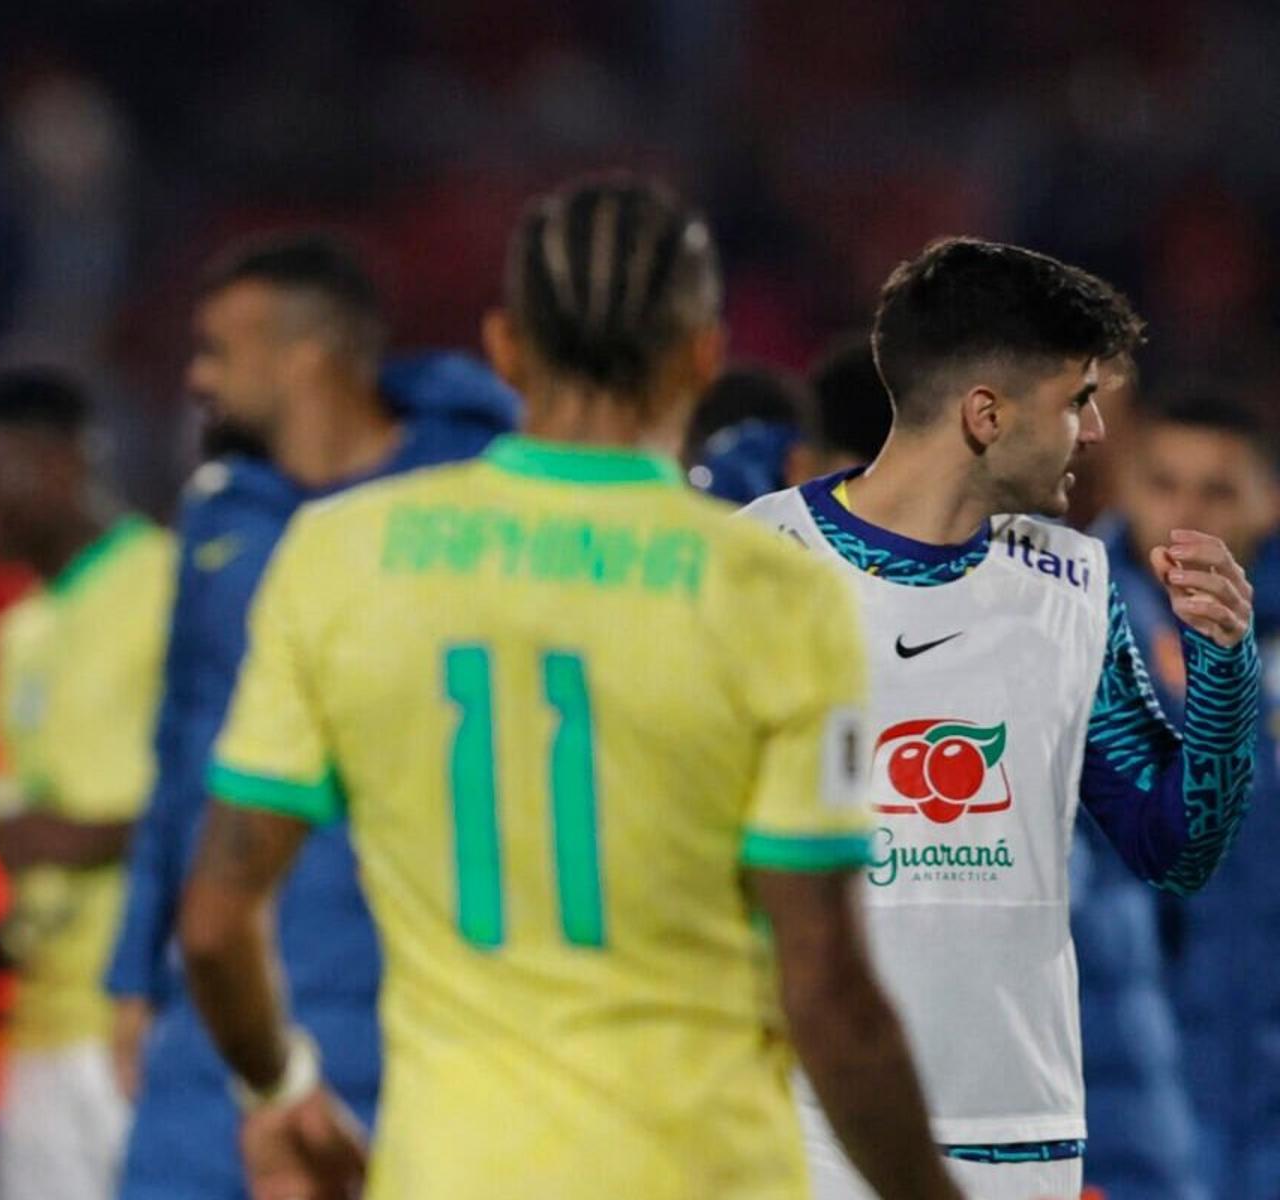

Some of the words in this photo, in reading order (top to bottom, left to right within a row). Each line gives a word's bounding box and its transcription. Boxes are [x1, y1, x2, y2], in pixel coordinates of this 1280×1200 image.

[445, 646, 604, 948] 11
[867, 827, 1014, 886] Guaraná
[912, 870, 999, 882] ANTARCTICA
